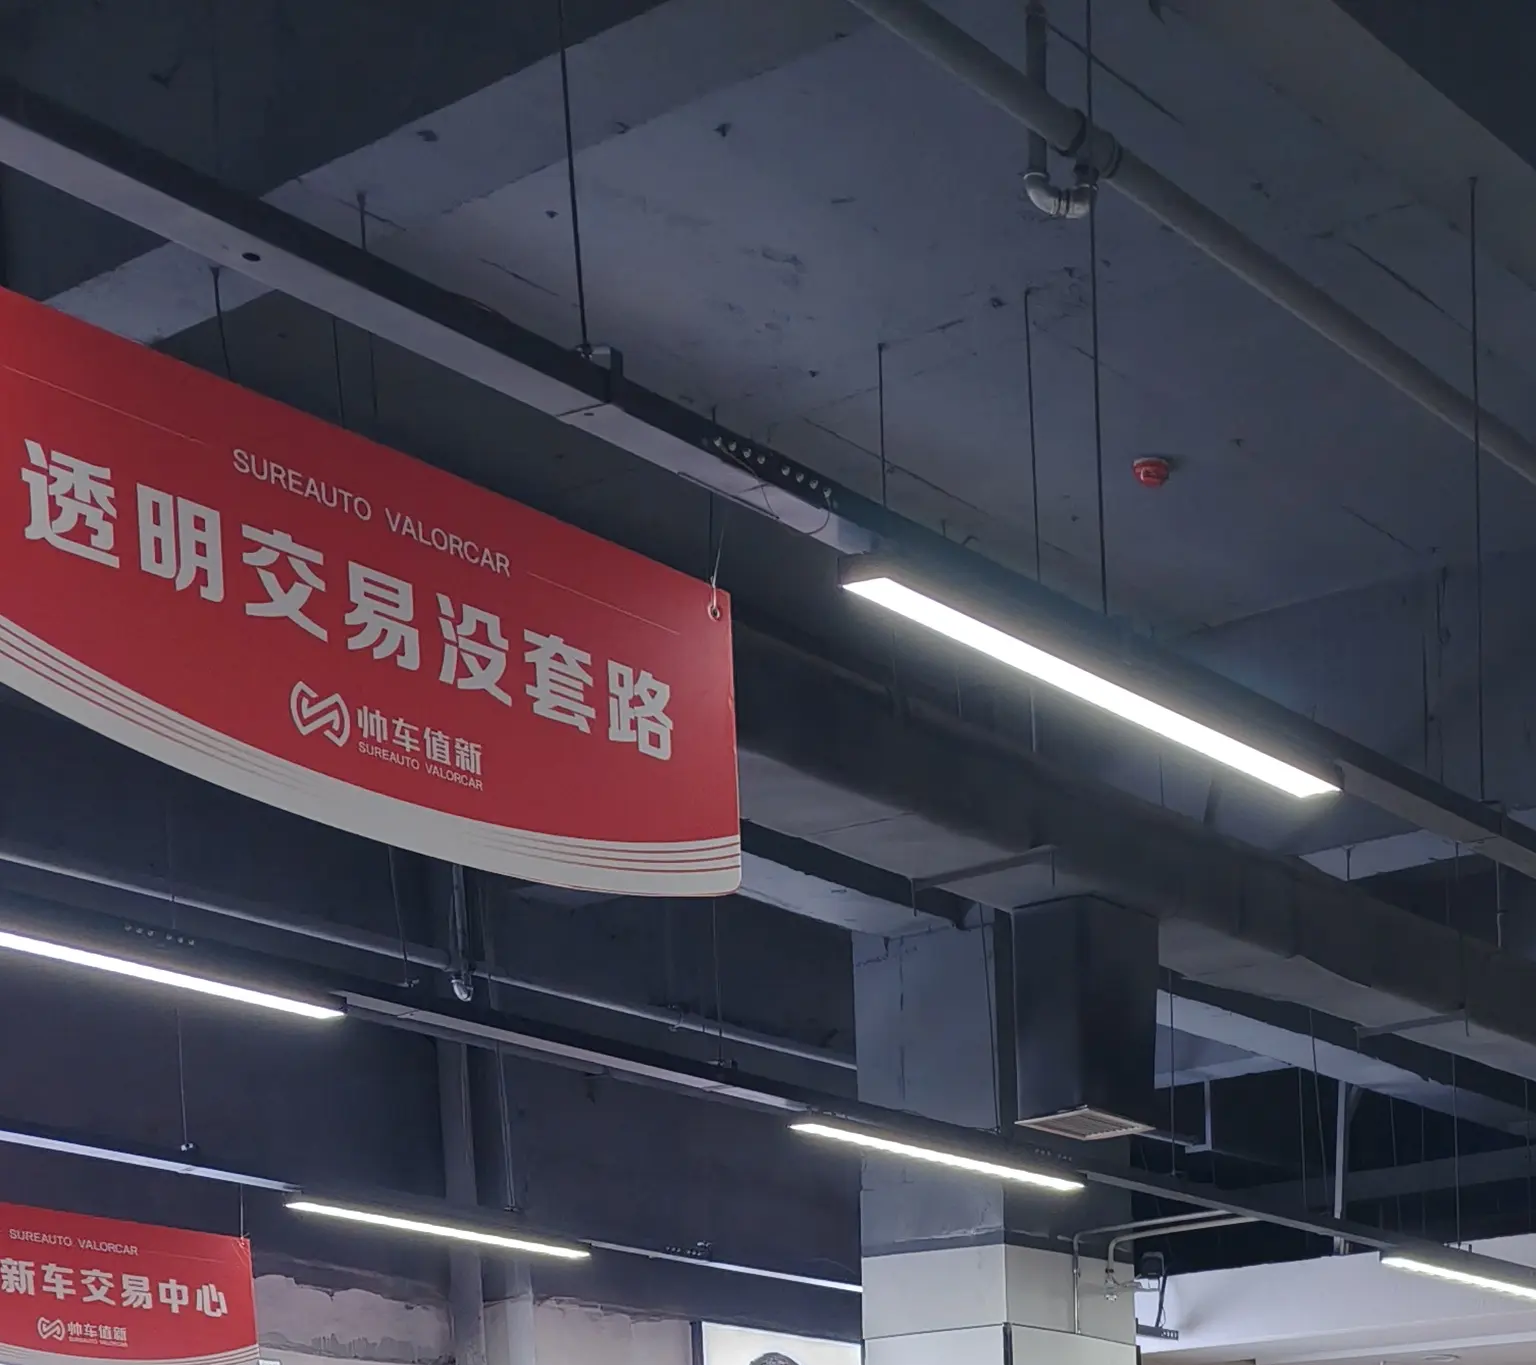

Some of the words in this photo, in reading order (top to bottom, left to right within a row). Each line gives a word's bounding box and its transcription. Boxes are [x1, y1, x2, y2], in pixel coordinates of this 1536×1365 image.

[232, 448, 373, 521] SUREAUTO
[384, 507, 511, 578] VALORCAR
[20, 439, 675, 763] 透明交易没套路
[356, 704, 484, 776] 帅车值新
[358, 741, 420, 770] SUREAUTO
[425, 763, 484, 792] VALORCAR
[9, 1229, 73, 1246] SUREAUTO
[78, 1239, 139, 1256] VALORCAR
[1, 1257, 228, 1318] 新车交易中心
